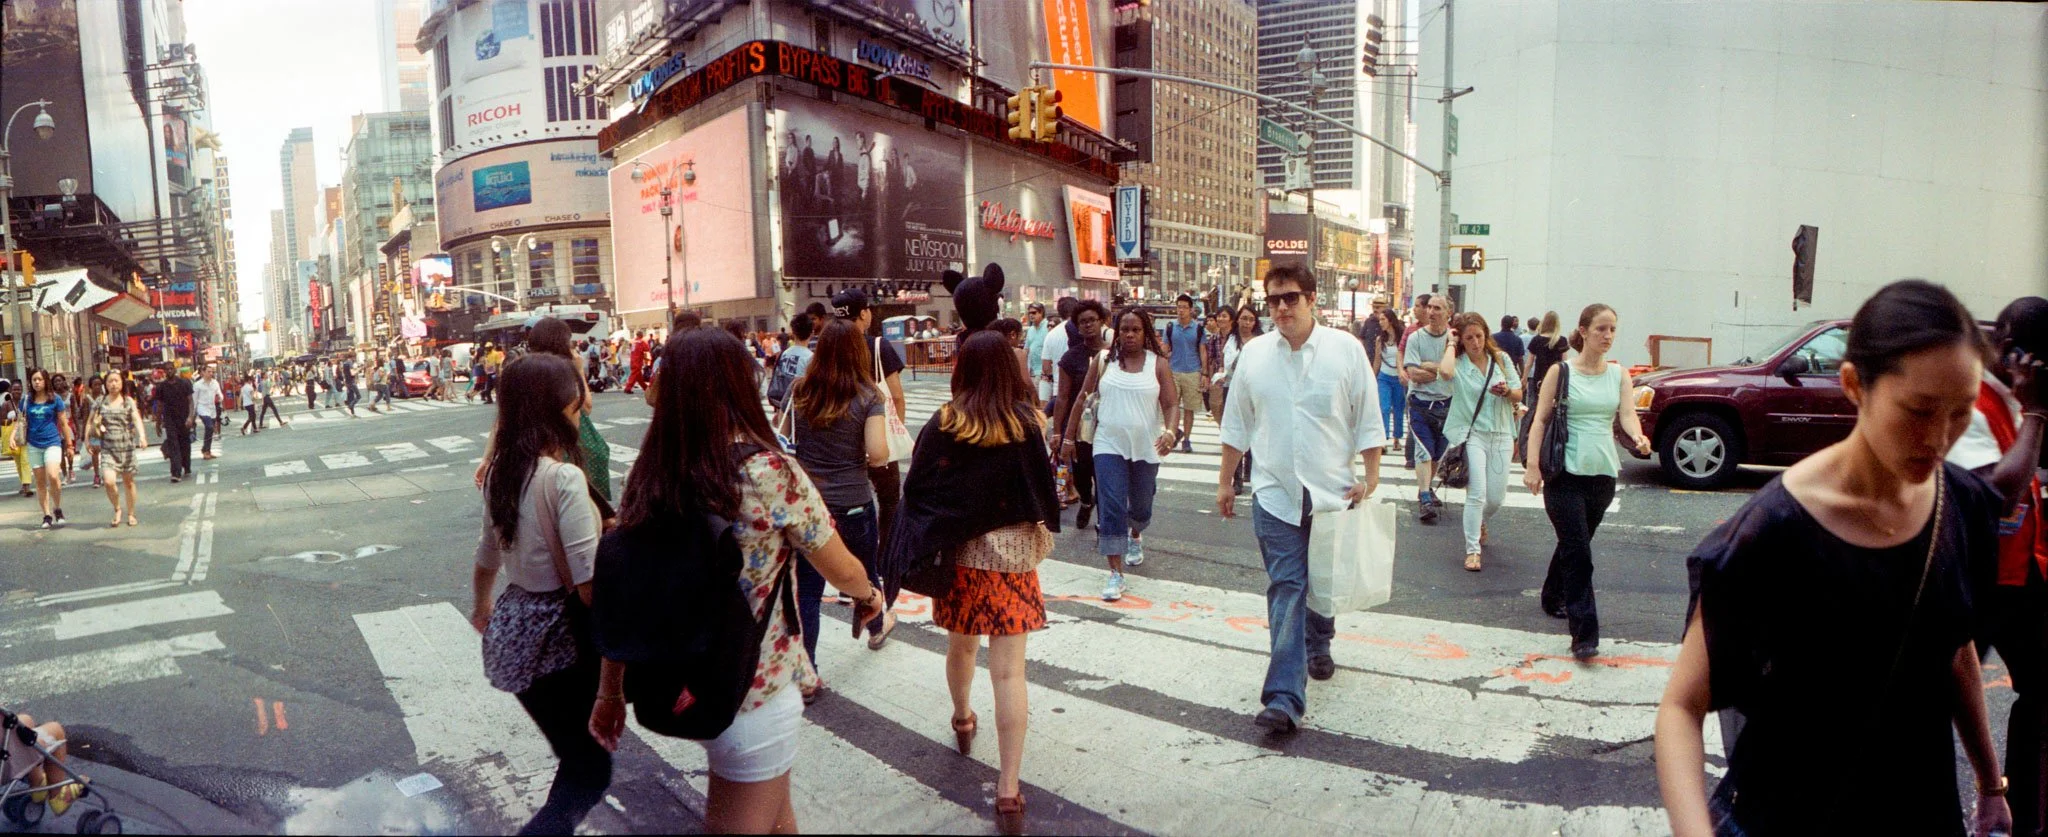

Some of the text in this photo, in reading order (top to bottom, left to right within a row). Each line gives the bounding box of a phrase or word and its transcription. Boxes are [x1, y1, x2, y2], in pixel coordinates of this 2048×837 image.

[706, 41, 765, 93] PROFITS
[778, 41, 841, 87] BYPASS
[847, 65, 869, 97] BIG
[468, 103, 521, 127] RICOH
[545, 214, 573, 223] CHASE
[981, 201, 1056, 242] Walgreens
[1124, 191, 1133, 241] NYPD
[905, 238, 964, 259] NEWSROOM
[906, 259, 924, 271] JULY
